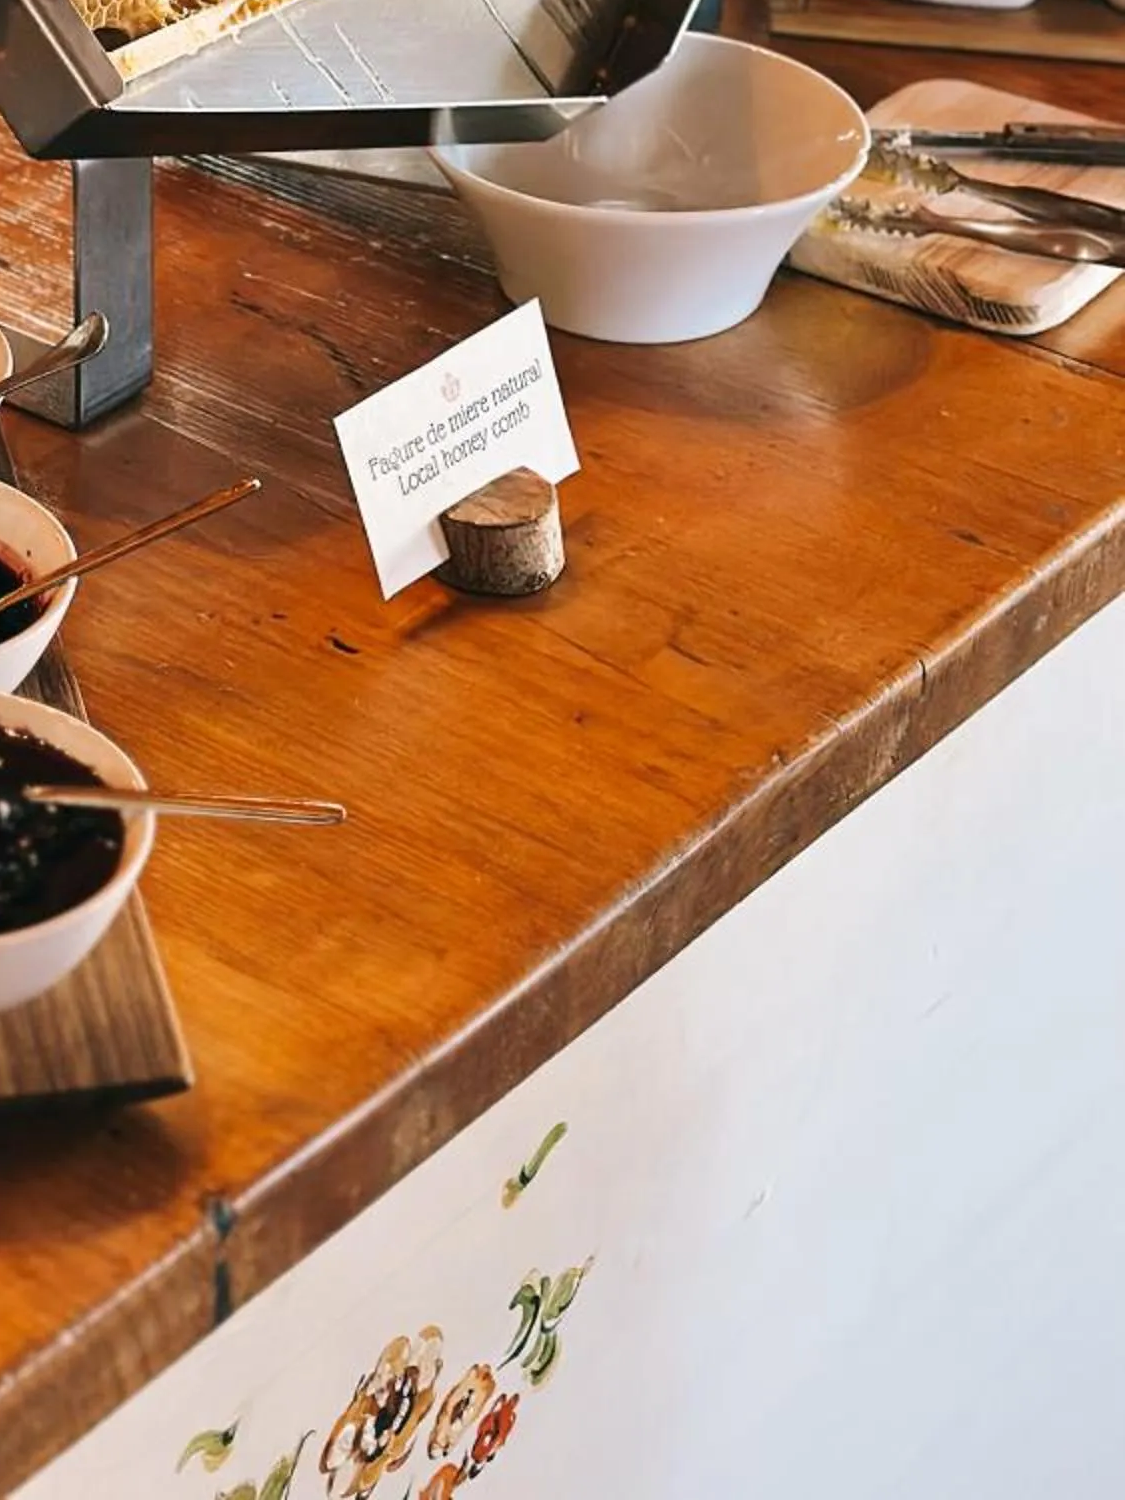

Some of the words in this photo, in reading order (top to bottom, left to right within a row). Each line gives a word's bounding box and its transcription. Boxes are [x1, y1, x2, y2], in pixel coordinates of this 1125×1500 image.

[426, 423, 448, 445] de
[448, 396, 490, 434] miere
[491, 358, 543, 406] natural
[398, 455, 440, 496] Local
[442, 427, 489, 469] honey
[491, 401, 530, 438] comb
